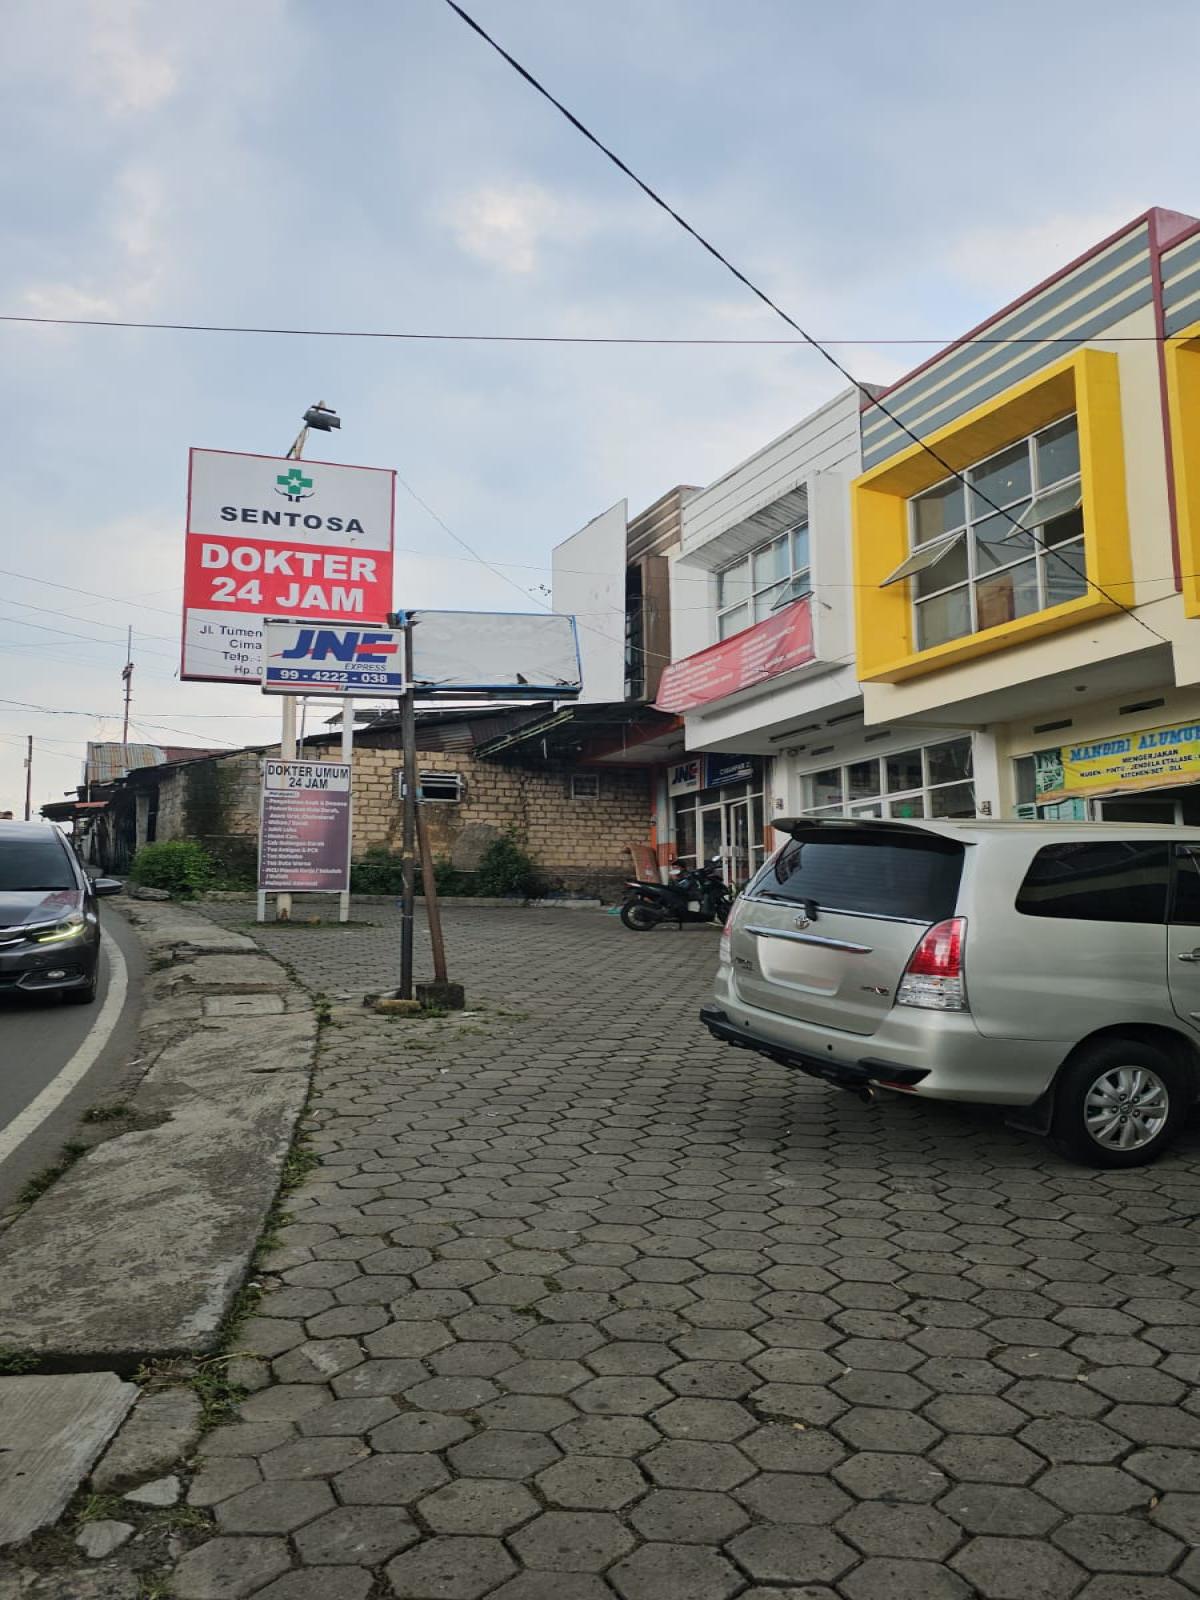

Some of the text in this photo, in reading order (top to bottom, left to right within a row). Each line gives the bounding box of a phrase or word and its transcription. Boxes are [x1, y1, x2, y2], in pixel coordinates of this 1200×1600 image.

[220, 506, 365, 533] SENTOSA
[201, 543, 378, 583] DOKTER
[210, 576, 364, 613] 24 JAM
[220, 625, 263, 637] Tumen
[229, 639, 262, 650] Cima
[269, 629, 399, 664] JNE
[345, 663, 387, 672] EXPRESS
[1070, 738, 1131, 762] MANDIRI
[268, 765, 349, 779] DOKTER UMUM
[289, 777, 328, 789] 24 JAM
